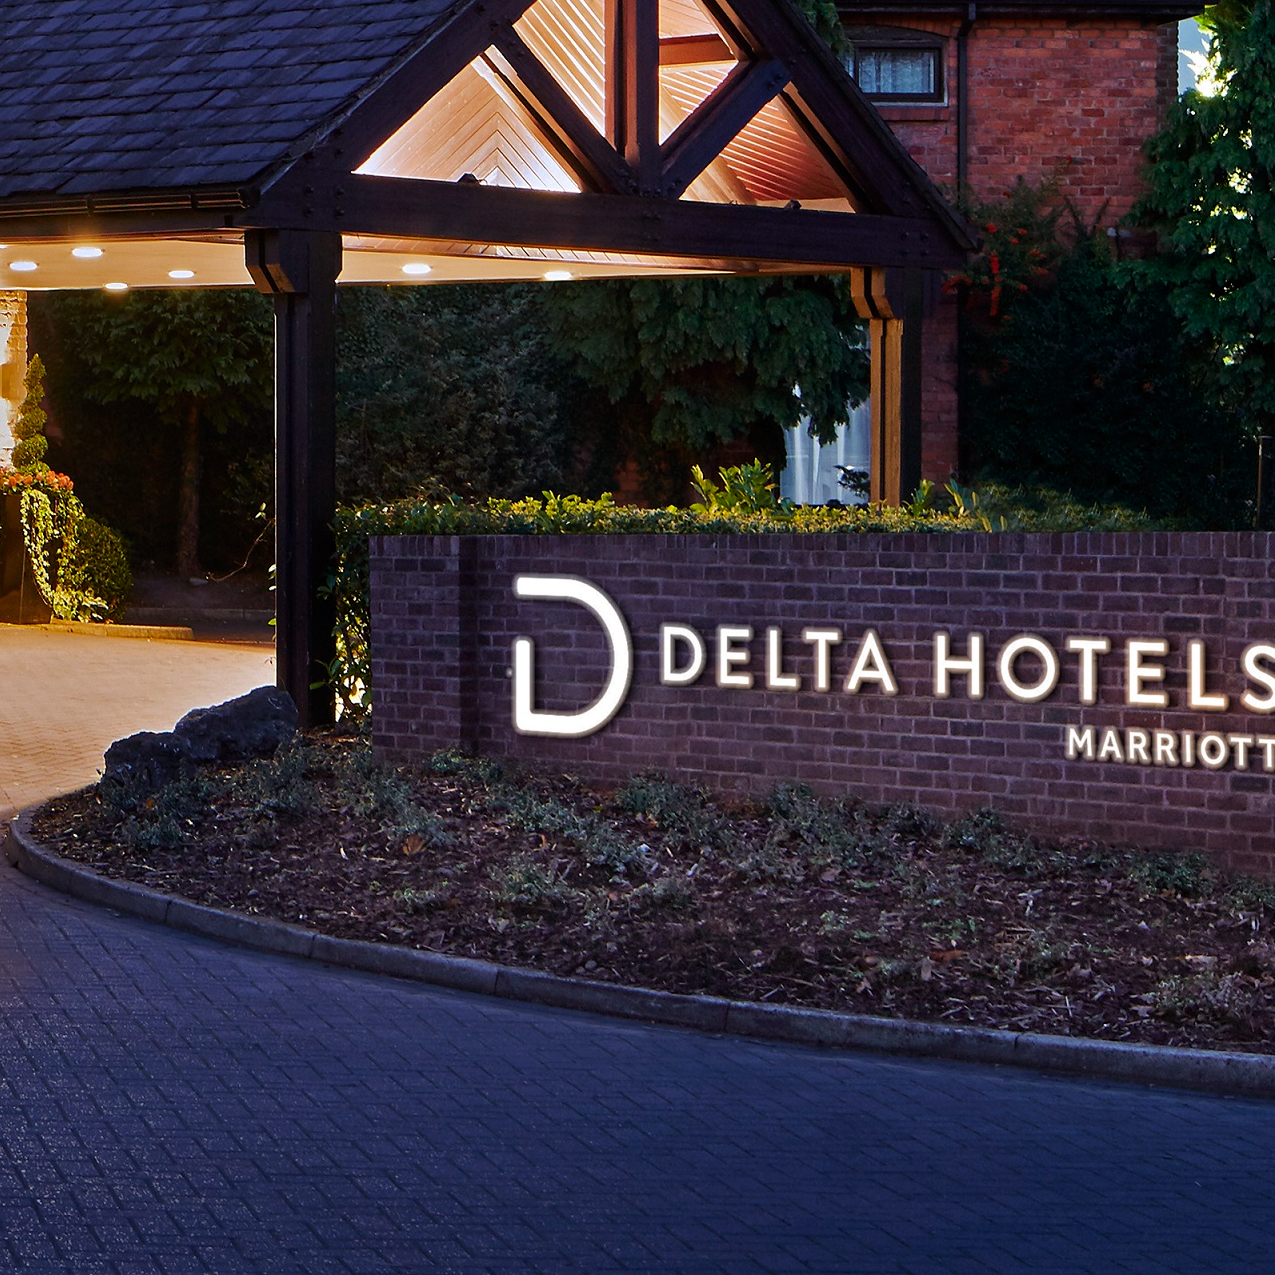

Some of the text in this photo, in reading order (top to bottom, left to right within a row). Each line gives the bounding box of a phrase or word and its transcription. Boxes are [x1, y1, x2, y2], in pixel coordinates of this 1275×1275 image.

[662, 625, 1275, 710] DELTA HOTELS
[1067, 727, 1275, 768] MARRIOTT
